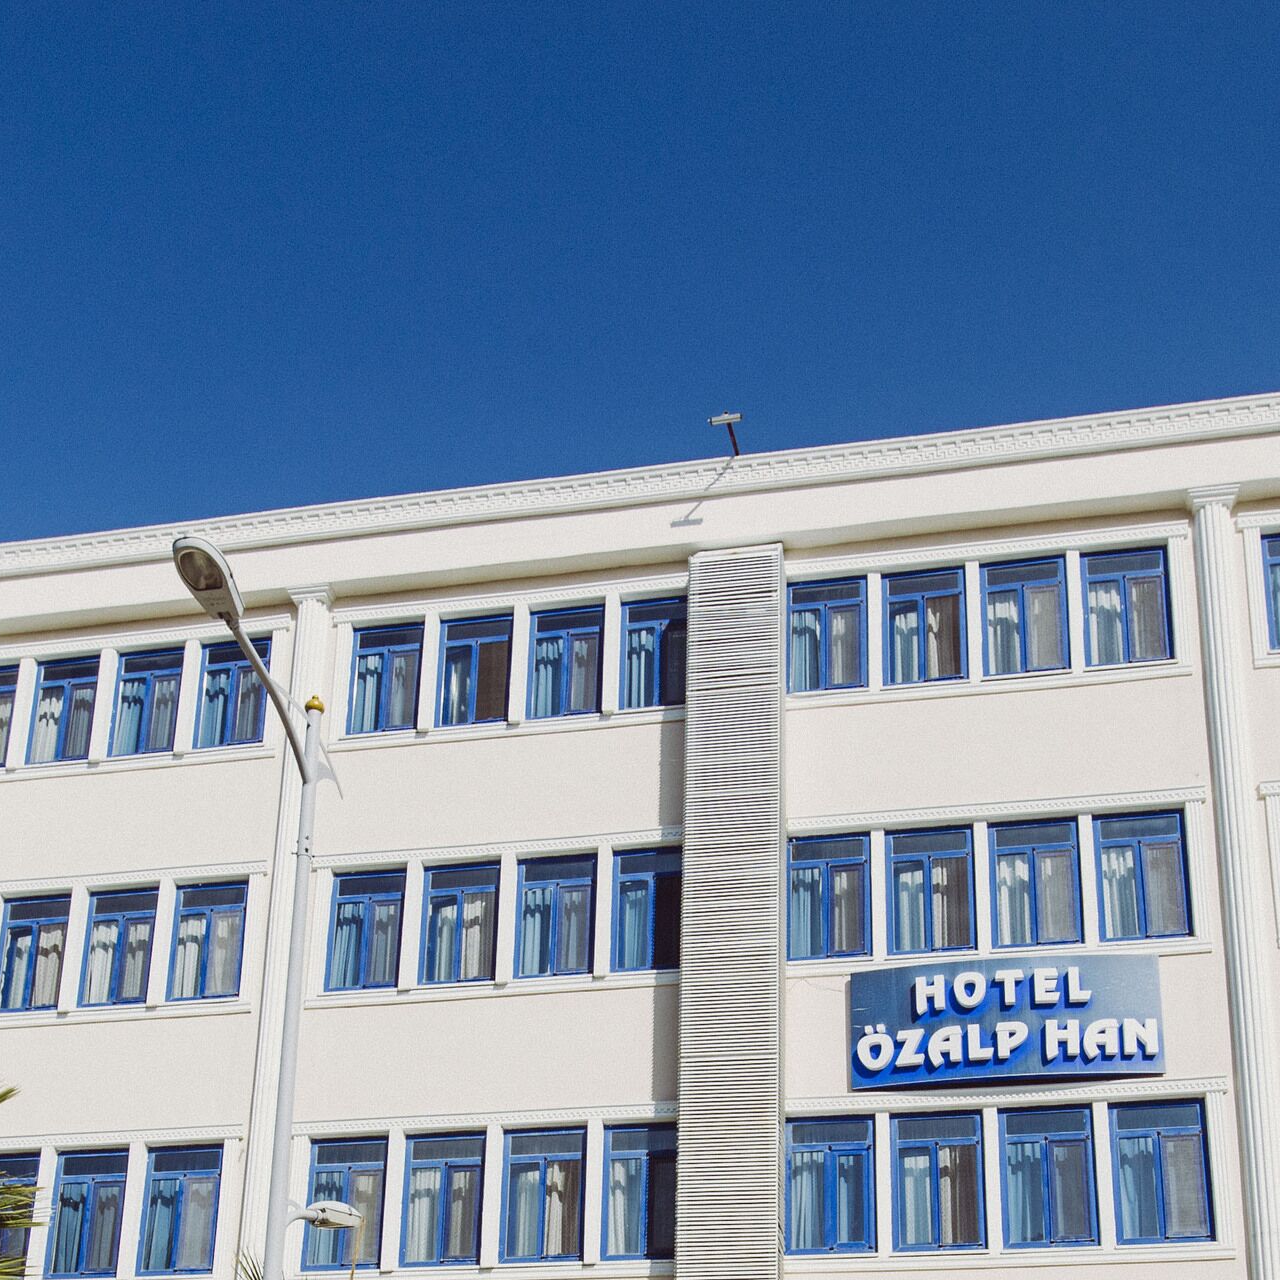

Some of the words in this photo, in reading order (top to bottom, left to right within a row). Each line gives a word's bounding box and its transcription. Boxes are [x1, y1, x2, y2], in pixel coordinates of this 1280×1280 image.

[916, 965, 1092, 1016] HOTEL
[856, 1021, 1028, 1072] ÖZALP
[1045, 1018, 1159, 1061] HAN
